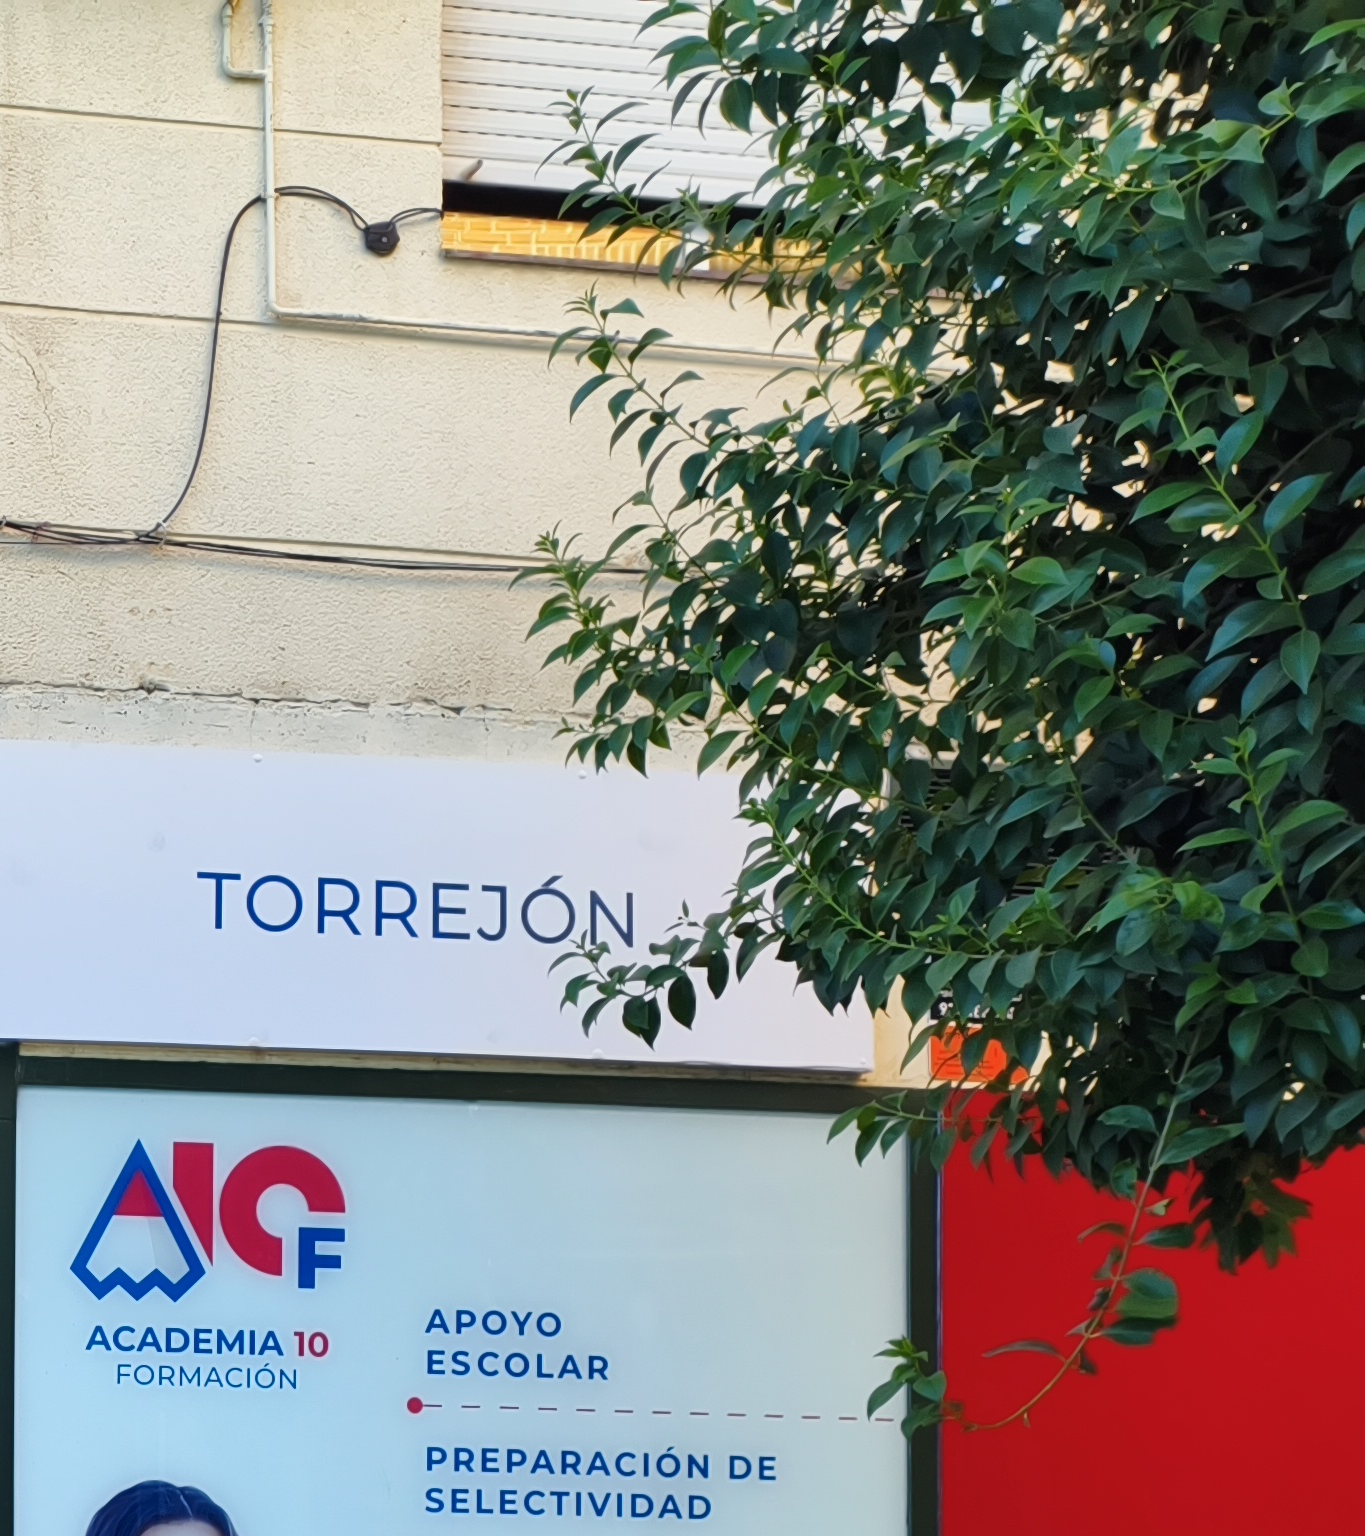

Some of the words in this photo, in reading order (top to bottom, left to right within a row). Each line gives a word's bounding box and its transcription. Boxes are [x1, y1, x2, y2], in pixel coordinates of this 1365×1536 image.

[197, 871, 633, 948] TORREJÓN
[425, 1308, 562, 1337] APOYO
[85, 1325, 284, 1356] ACADEMIA
[293, 1331, 329, 1357] 10
[117, 1363, 297, 1389] FORMACIÓN
[426, 1350, 609, 1380] ESCOLAR
[426, 1446, 709, 1479] PREPARACIÓN
[728, 1456, 777, 1480] DE
[425, 1487, 712, 1520] SELECTIVIDAD
